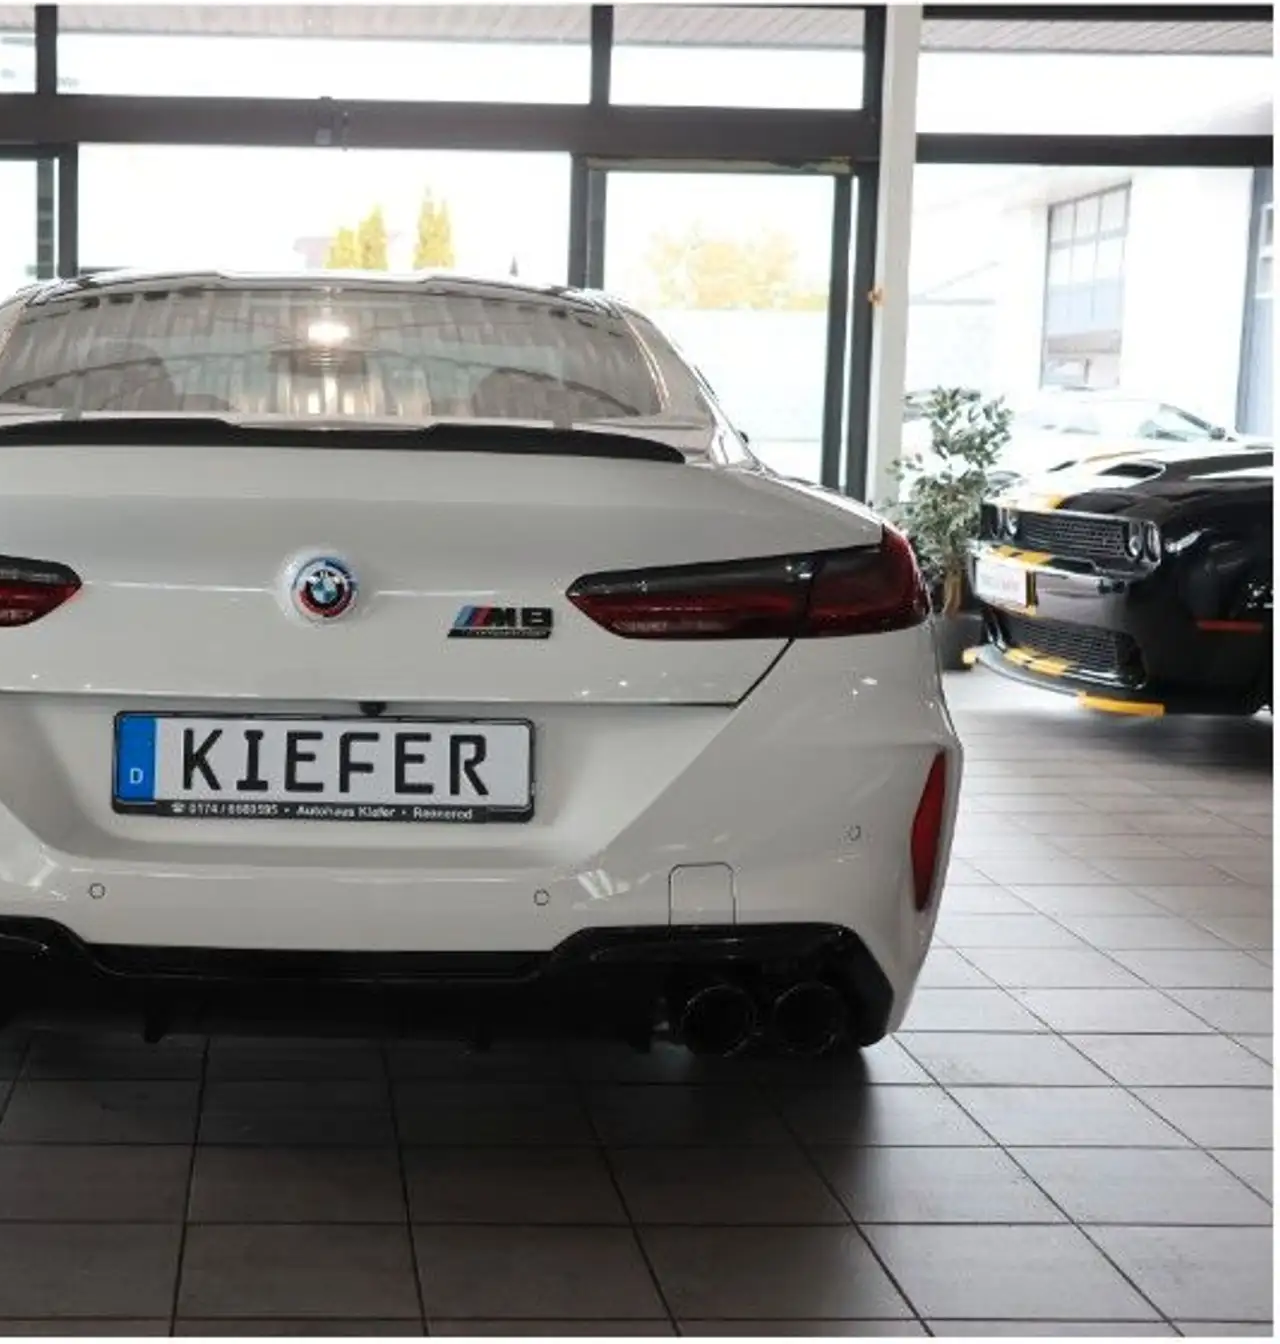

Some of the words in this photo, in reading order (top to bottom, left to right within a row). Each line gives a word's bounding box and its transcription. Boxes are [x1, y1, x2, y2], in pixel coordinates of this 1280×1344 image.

[182, 728, 489, 796] KIEFER
[129, 768, 144, 784] D
[296, 806, 355, 818] Autohaus
[358, 806, 396, 818] Kiefer
